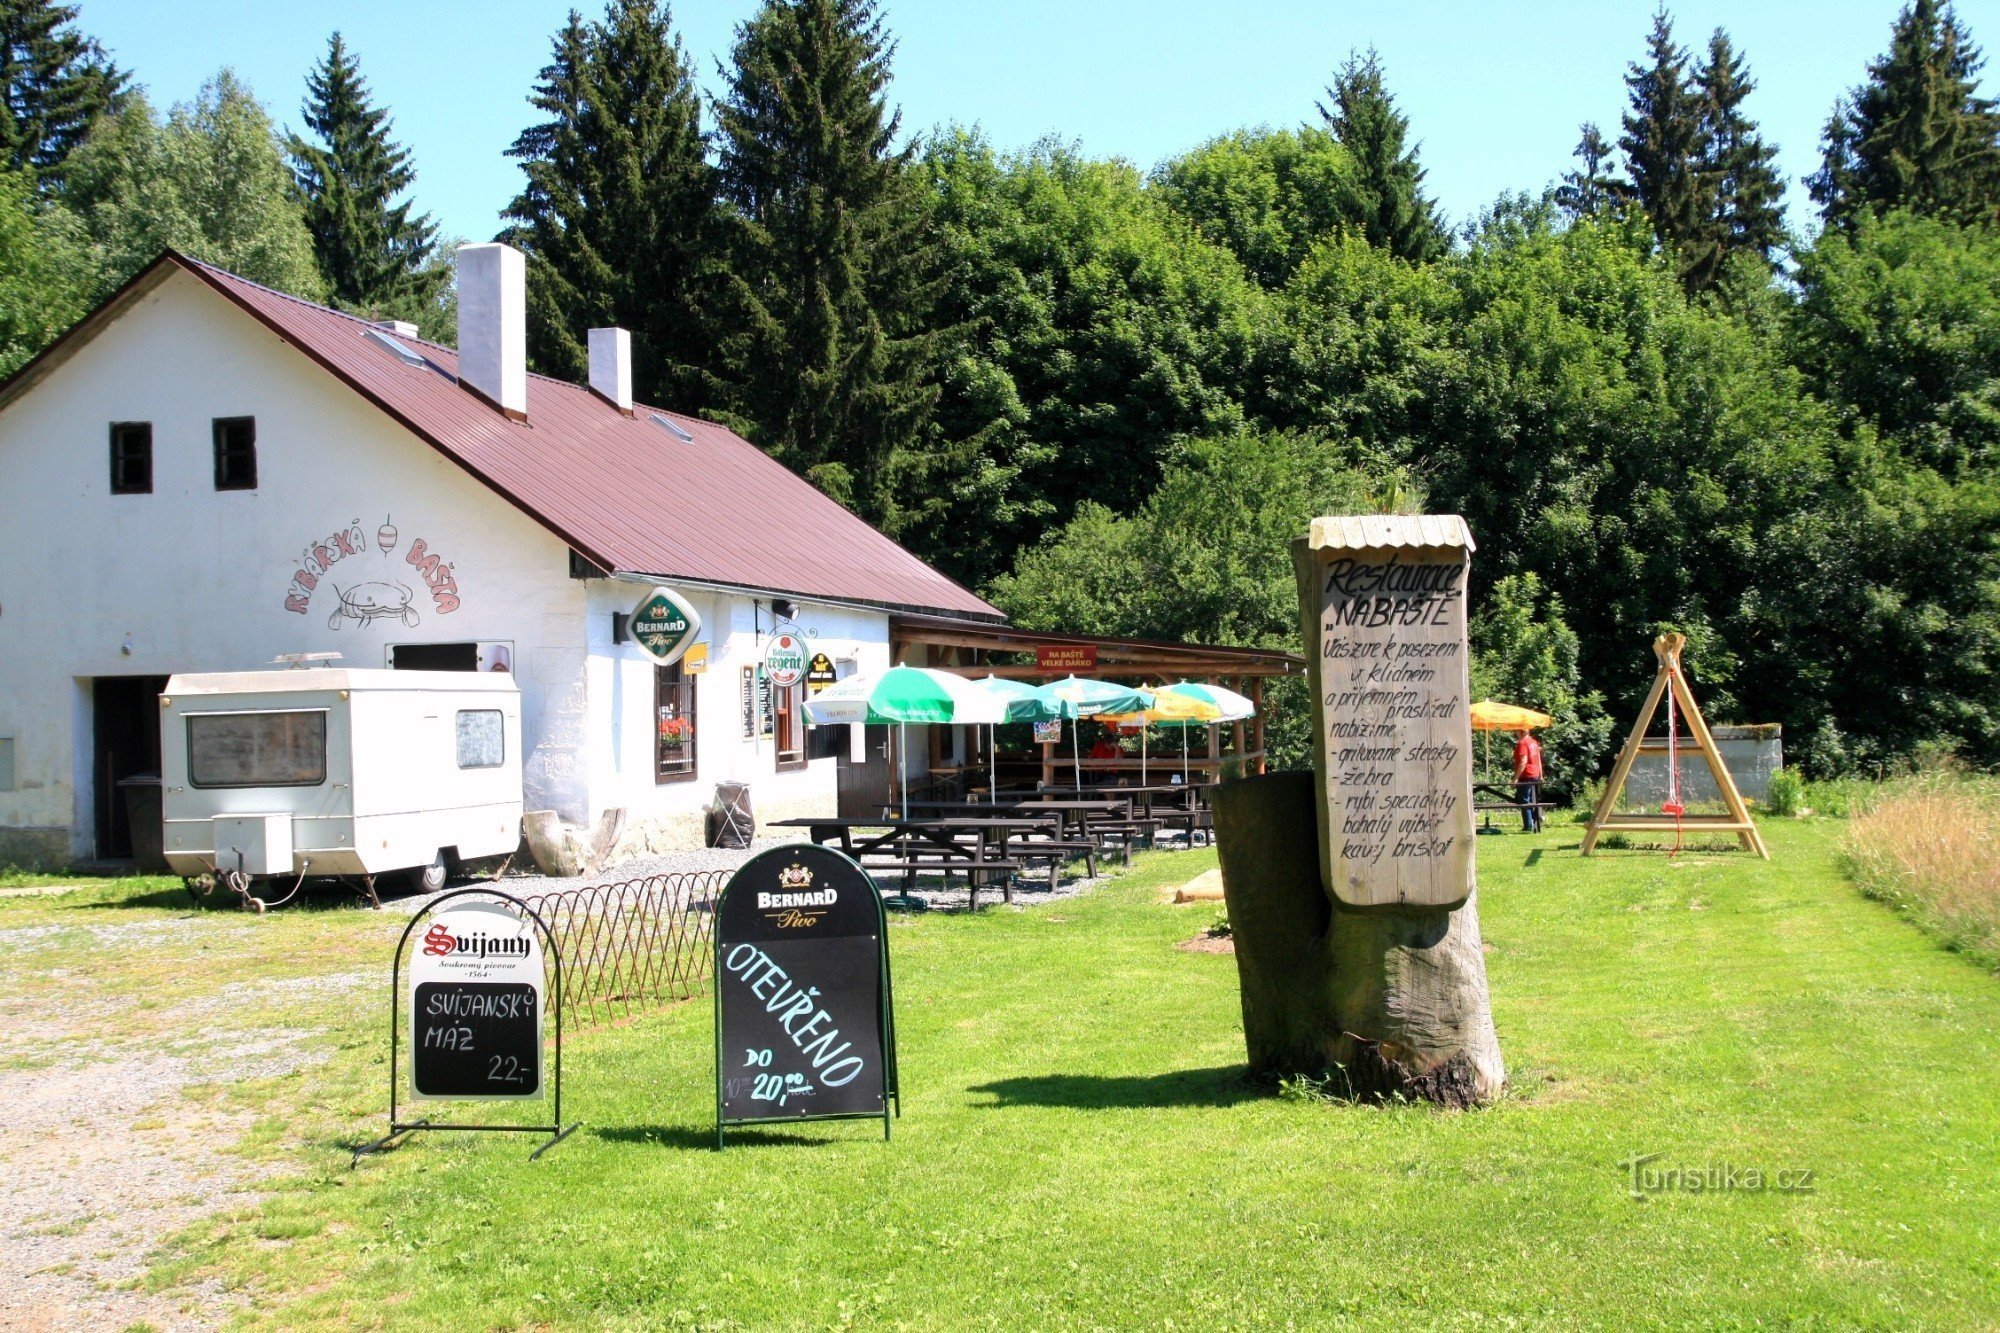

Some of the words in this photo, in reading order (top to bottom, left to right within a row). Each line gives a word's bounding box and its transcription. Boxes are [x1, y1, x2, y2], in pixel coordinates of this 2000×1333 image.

[285, 518, 365, 614] RYBÁŘSKÁ
[406, 538, 460, 614] BAŠTA
[1325, 553, 1462, 596] Restaurace
[637, 620, 685, 632] BERNARD
[649, 633, 672, 645] Pivo
[1382, 633, 1396, 660] k
[767, 656, 802, 671] regent
[1042, 659, 1064, 667] VELKÉ
[1066, 659, 1092, 667] DÁŘKO
[1061, 650, 1085, 658] BAŠTĚ
[1404, 741, 1458, 771] steaky
[757, 888, 838, 909] BERNARD
[777, 909, 818, 929] Pivo
[422, 924, 531, 959] Svijany
[484, 961, 516, 969] pivovar
[726, 943, 864, 1087] OTEVŘENO
[743, 1048, 773, 1067] DO
